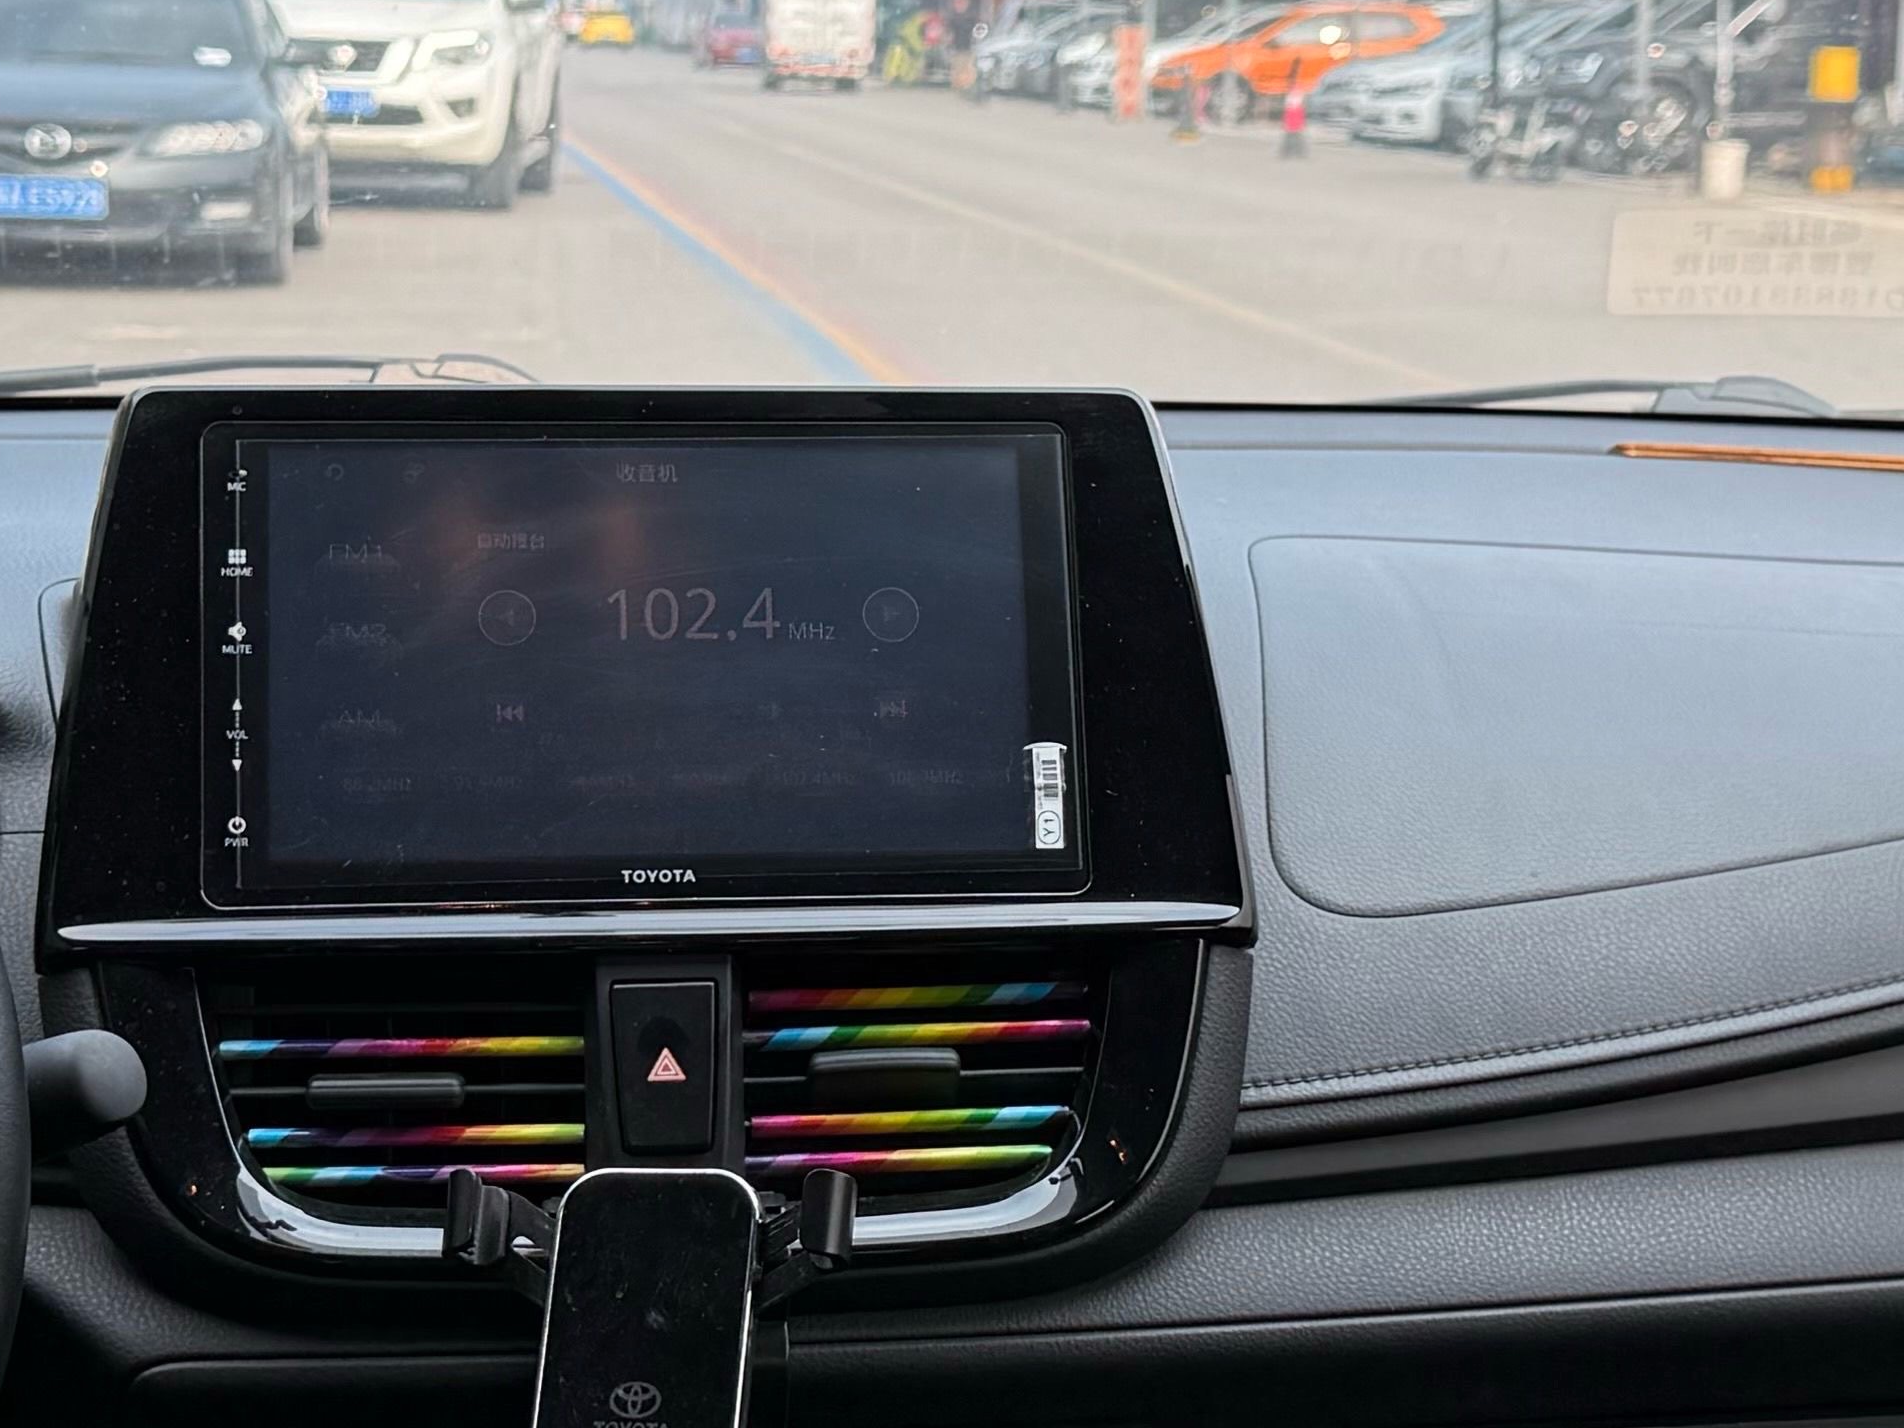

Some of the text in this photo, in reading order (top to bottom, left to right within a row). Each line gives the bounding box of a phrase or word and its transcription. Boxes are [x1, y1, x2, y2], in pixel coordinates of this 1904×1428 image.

[615, 463, 679, 484] 收音机
[220, 565, 254, 578] HOME
[605, 586, 837, 642] 102.4 MHz
[220, 643, 254, 656] MUTE
[225, 728, 249, 741] VOL
[223, 837, 250, 849] PWR
[620, 868, 698, 886] TOYOTA
